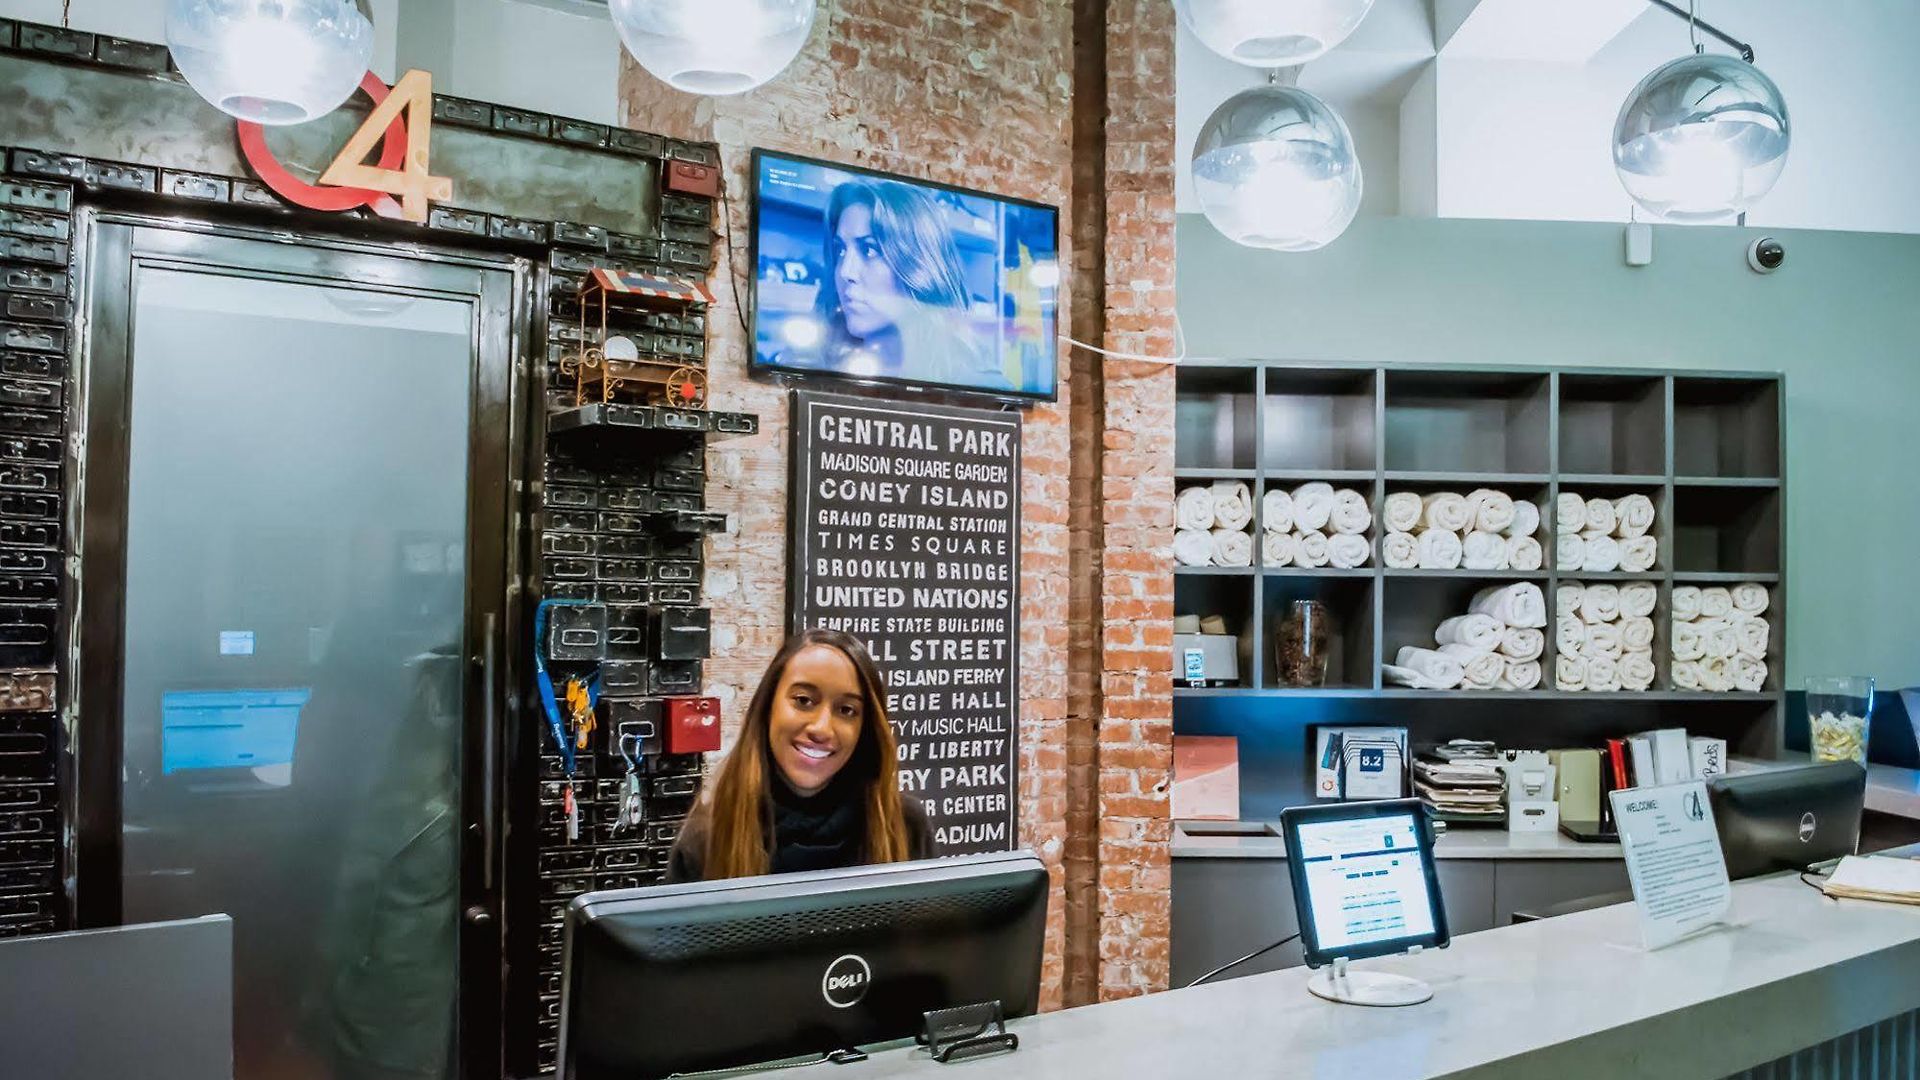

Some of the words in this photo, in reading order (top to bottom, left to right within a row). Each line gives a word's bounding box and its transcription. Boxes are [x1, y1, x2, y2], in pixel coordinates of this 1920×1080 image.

[819, 414, 938, 451] CENTRAL
[949, 427, 1010, 457] PARK
[821, 452, 890, 474] MADISON
[894, 458, 951, 479] SQUARE
[955, 463, 1007, 483] GARDEN
[820, 478, 910, 503] CONEY
[922, 486, 1008, 509] ISLAND
[818, 510, 872, 526] GRAND
[878, 513, 944, 530] CENTRAL
[950, 517, 1006, 533] STATION
[818, 532, 894, 551] TIMES
[912, 536, 1006, 555] SQUARE
[817, 558, 925, 578] BROOKLYN
[937, 563, 1008, 581] BRIDGE
[816, 586, 905, 608] UNITED
[913, 588, 1008, 609] NATIONS
[818, 617, 880, 632] EMPIRE
[887, 617, 932, 632] STATE
[938, 617, 1004, 633] BUILDING
[867, 640, 897, 661] LL
[910, 639, 1006, 661] STREET
[888, 669, 950, 687] ISLAND
[954, 668, 1004, 686] FERRY
[887, 693, 940, 712] EGIE
[952, 692, 1006, 709] HALL
[912, 718, 963, 736] MUSIC
[967, 715, 1006, 734] HALL
[896, 742, 920, 761] OF
[929, 739, 1004, 760] LIBERTY
[1361, 755, 1382, 767] 8.2
[940, 764, 1006, 790] PARK
[943, 793, 1005, 815] CENTER
[935, 822, 1005, 844] ADIUM
